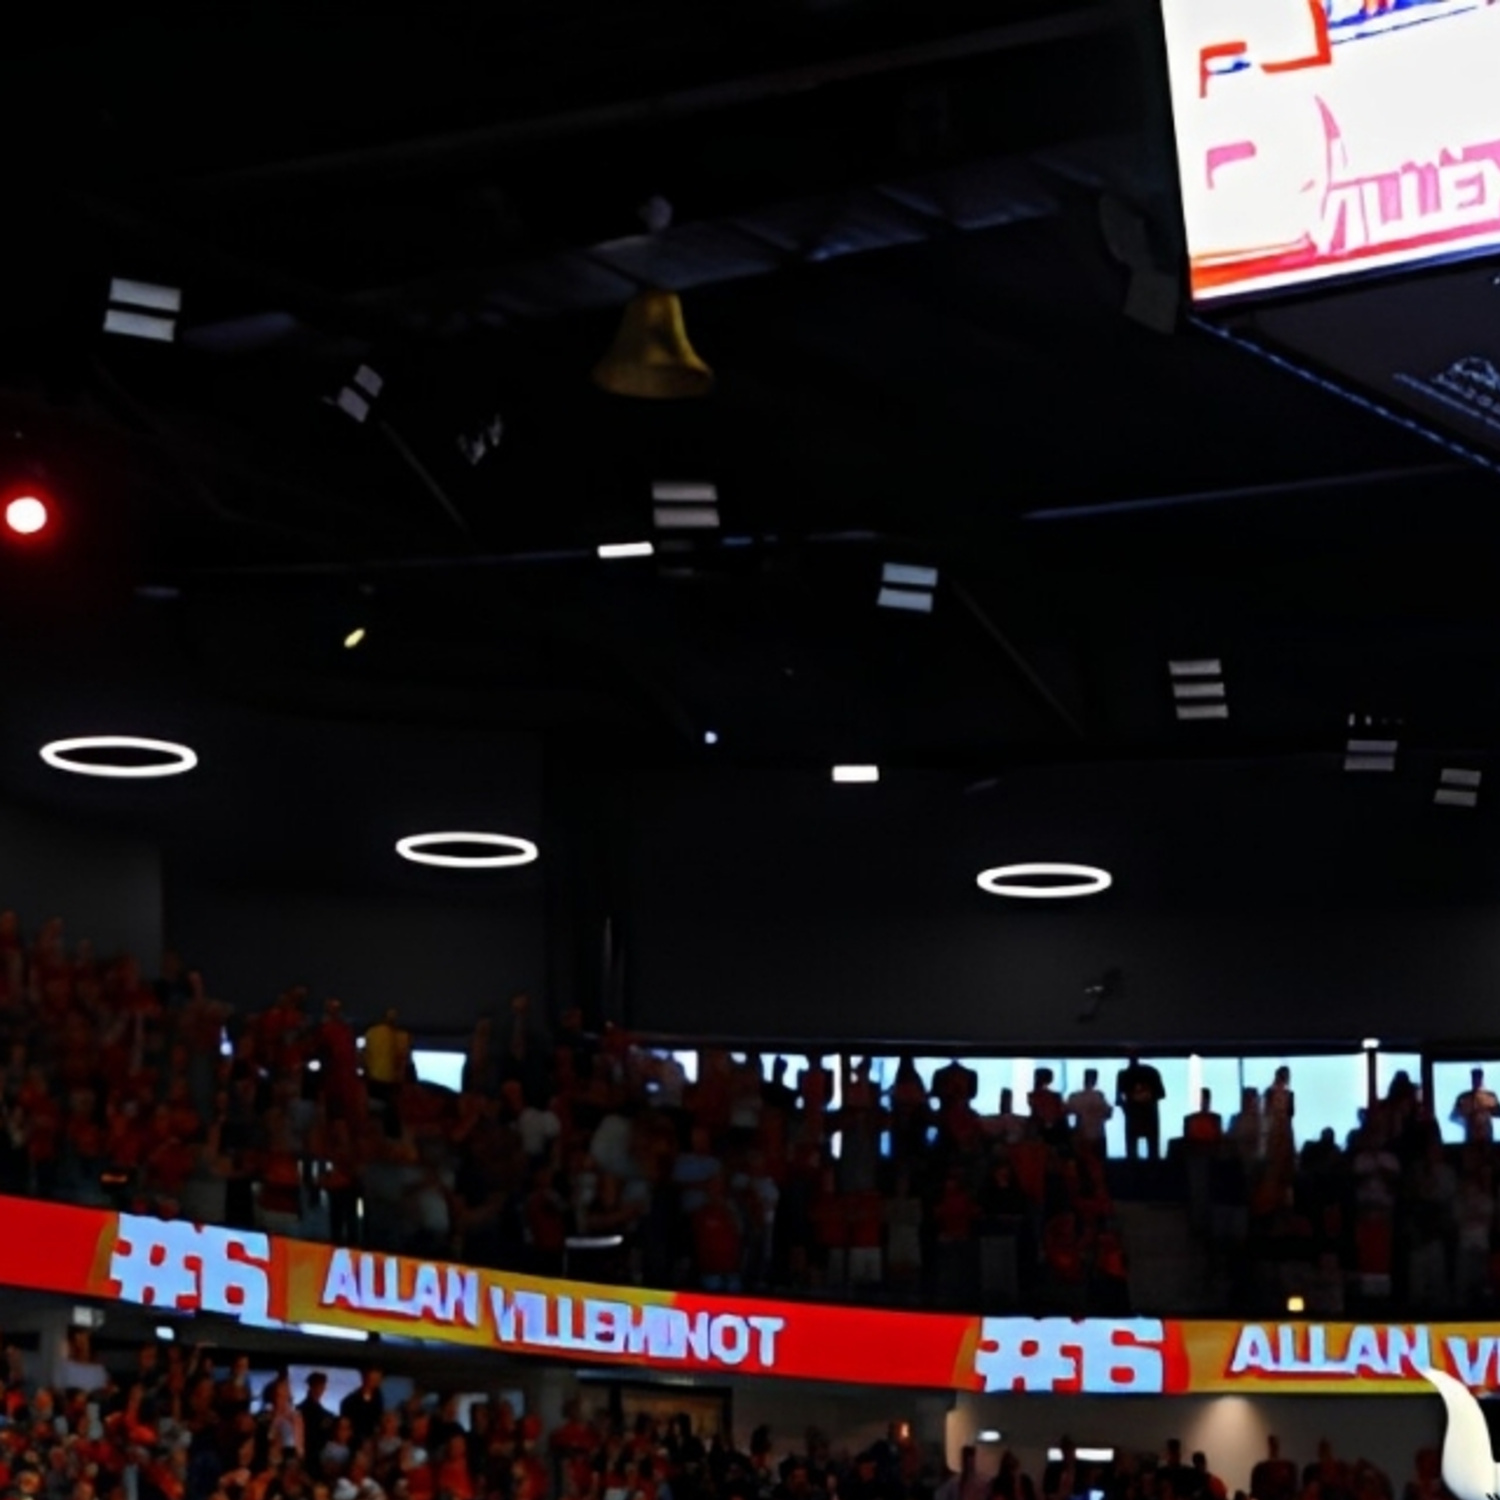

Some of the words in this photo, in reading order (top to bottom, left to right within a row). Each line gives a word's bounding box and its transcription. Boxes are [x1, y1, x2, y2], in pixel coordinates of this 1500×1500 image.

[322, 1247, 480, 1326] ALLAN
[489, 1286, 785, 1366] VILLEMINOT
[1230, 1324, 1430, 1374] ALLAN
